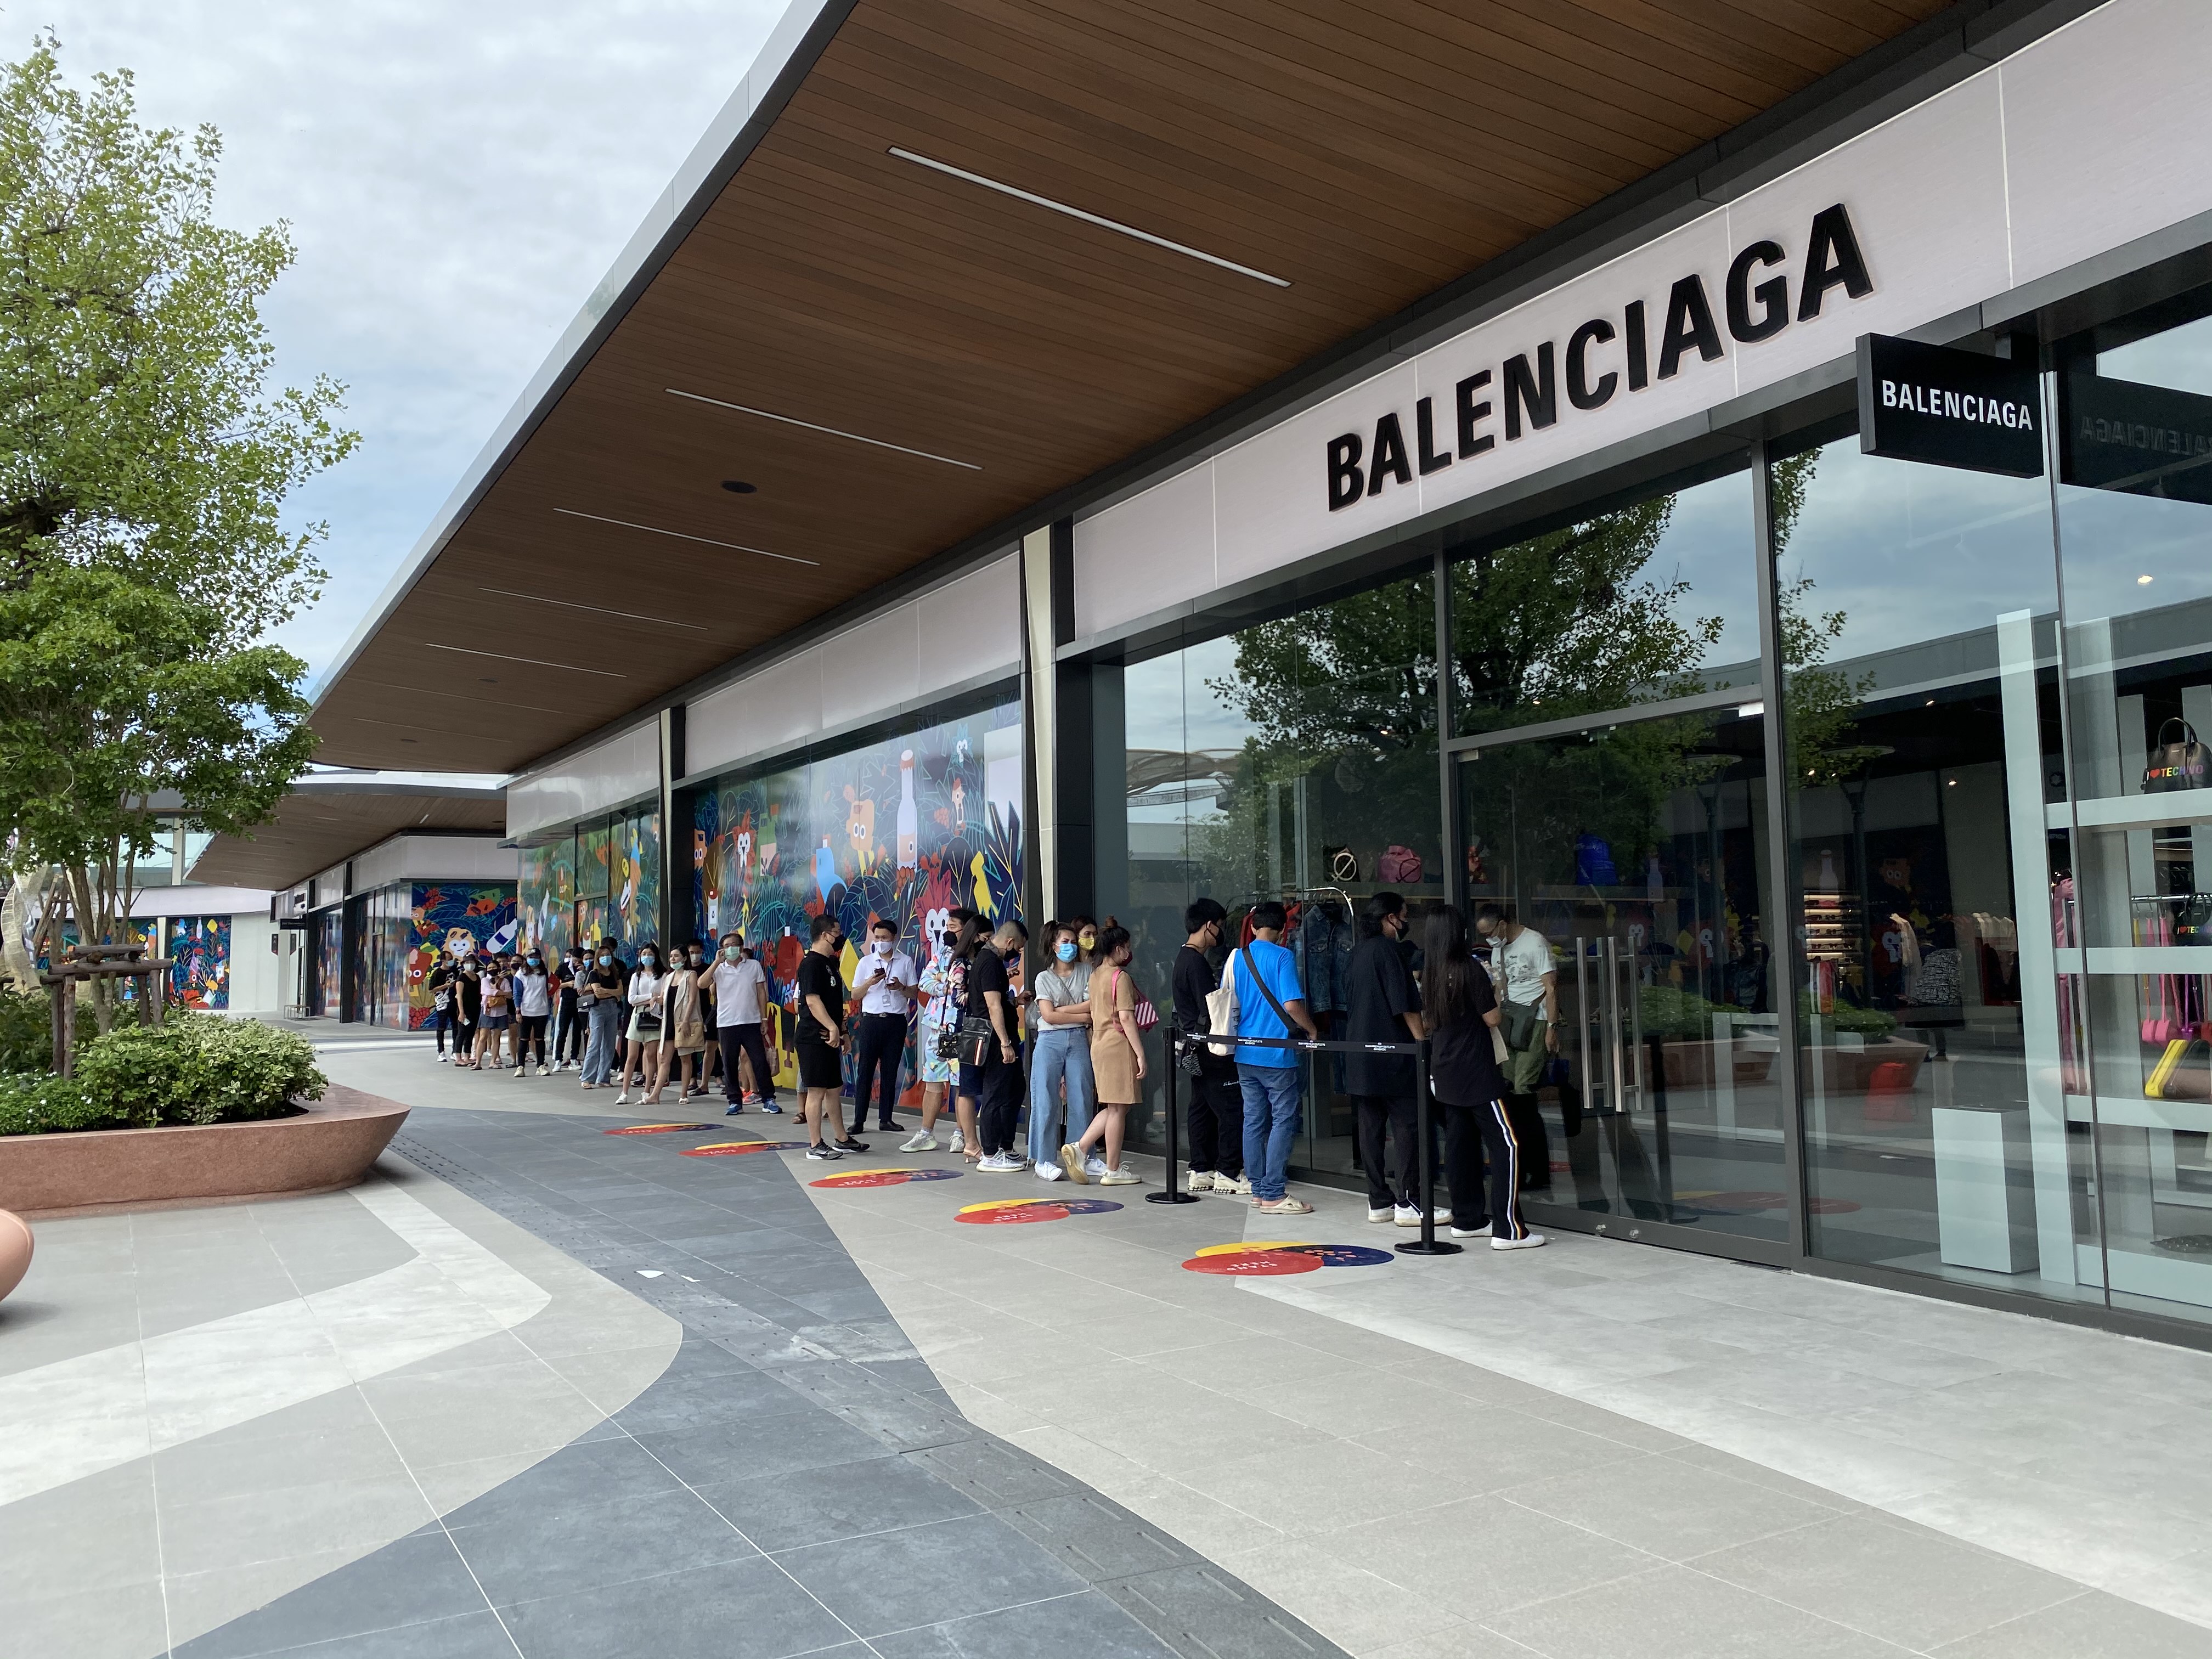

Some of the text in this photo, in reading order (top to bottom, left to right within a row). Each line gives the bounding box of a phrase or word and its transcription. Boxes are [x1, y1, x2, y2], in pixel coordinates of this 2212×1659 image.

[1327, 202, 1874, 512] BALENCIAGA
[1882, 380, 2033, 431] BALENCIAGA
[2161, 764, 2204, 777] TECHNO
[2187, 926, 2212, 934] TEC
